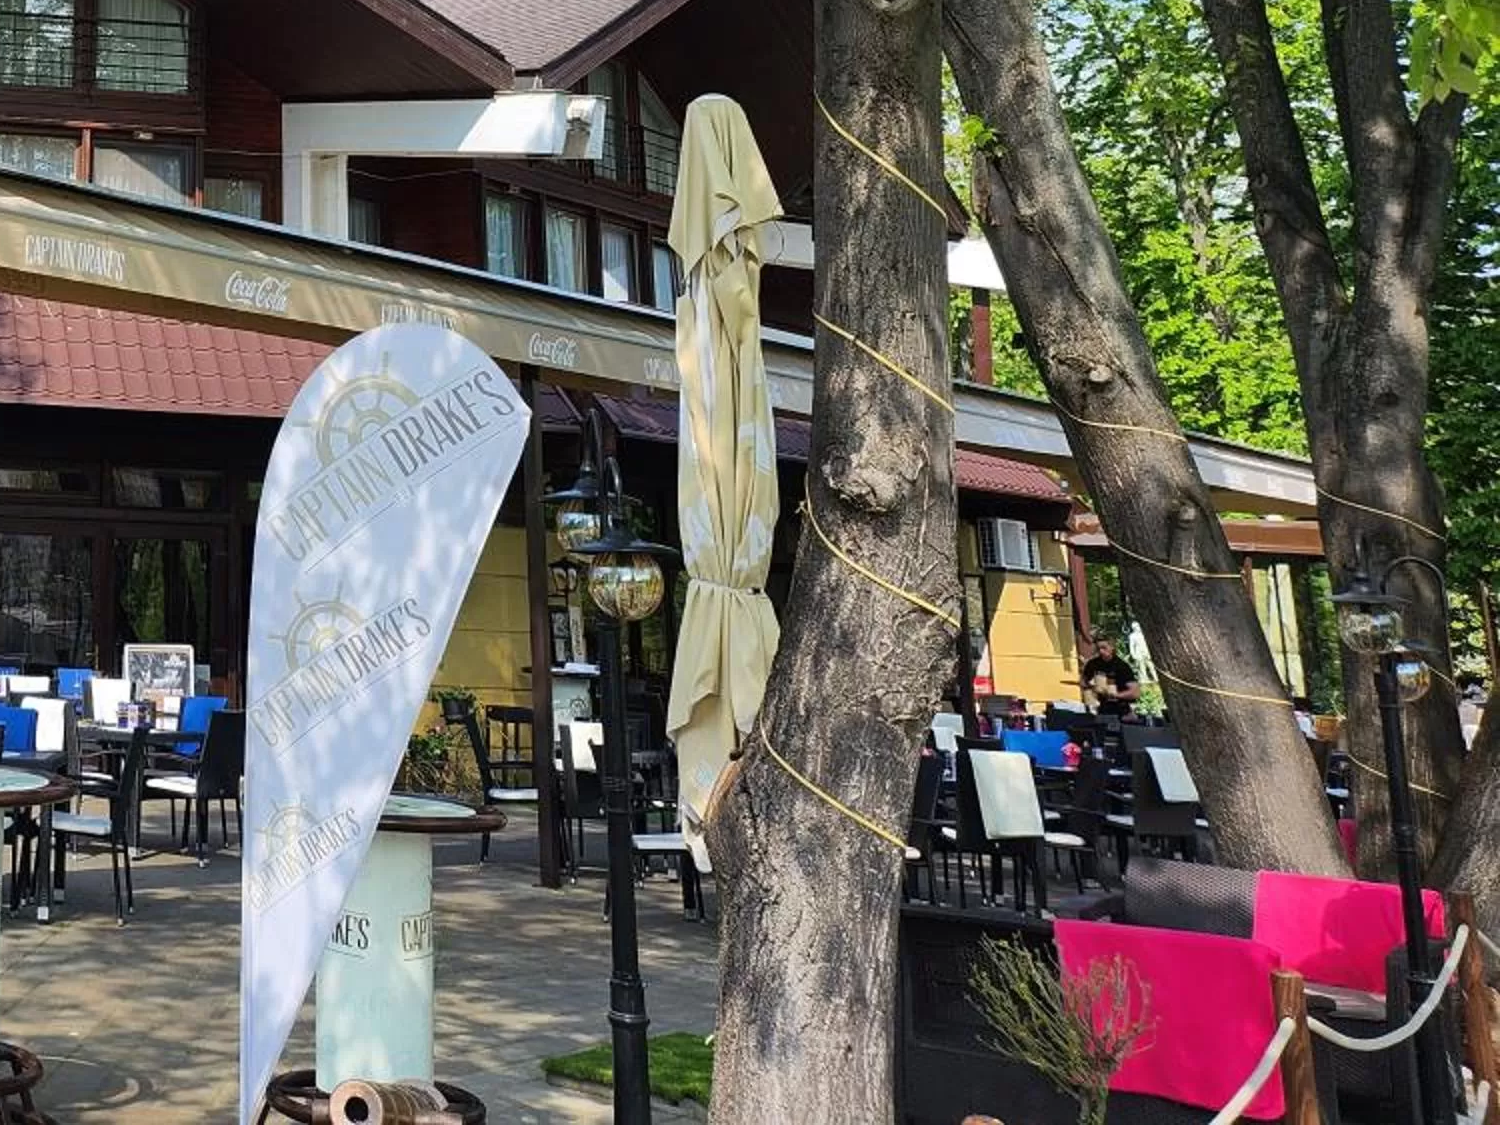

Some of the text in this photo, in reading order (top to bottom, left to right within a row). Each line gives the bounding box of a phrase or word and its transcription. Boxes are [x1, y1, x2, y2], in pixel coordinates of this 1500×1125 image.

[25, 235, 76, 271] CAPTAIN
[77, 240, 127, 282] DRAKE'S
[268, 370, 516, 562] CAPTAIN DRAKE'S
[250, 598, 431, 748] CAPTAIN DRAKE'S
[298, 807, 361, 866] DRAKE'S
